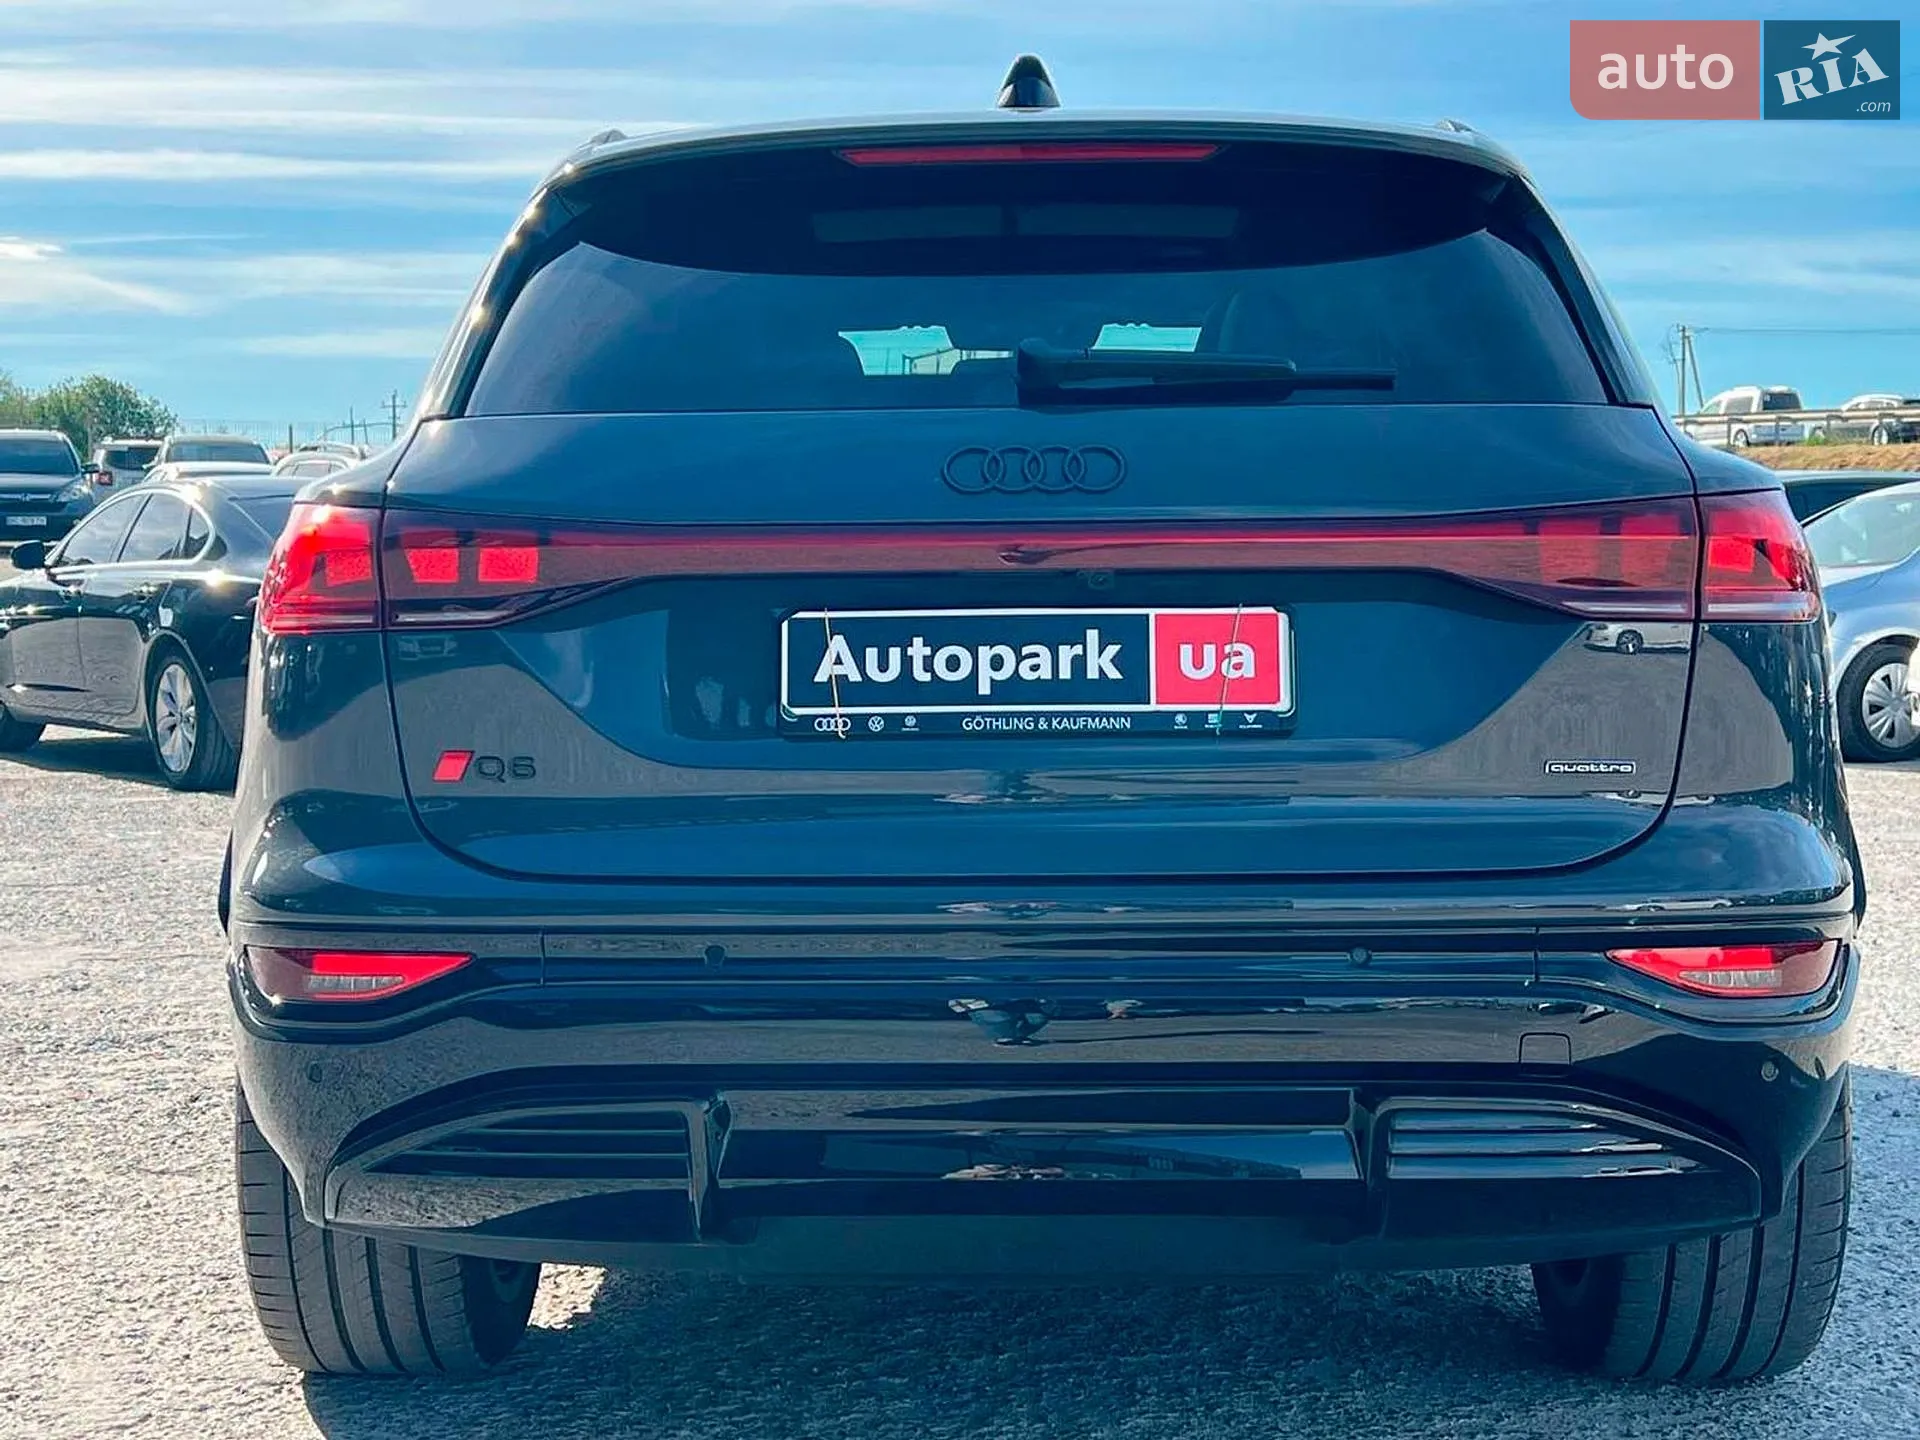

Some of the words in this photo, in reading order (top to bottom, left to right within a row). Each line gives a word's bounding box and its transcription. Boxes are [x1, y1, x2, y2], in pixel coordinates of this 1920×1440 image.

[813, 629, 1124, 695] Autopark
[1178, 640, 1257, 680] ua
[962, 715, 1034, 730] GÖTHLING
[1038, 717, 1049, 730] &
[1051, 717, 1132, 730] KAUFMANN
[1550, 763, 1632, 774] quattro
